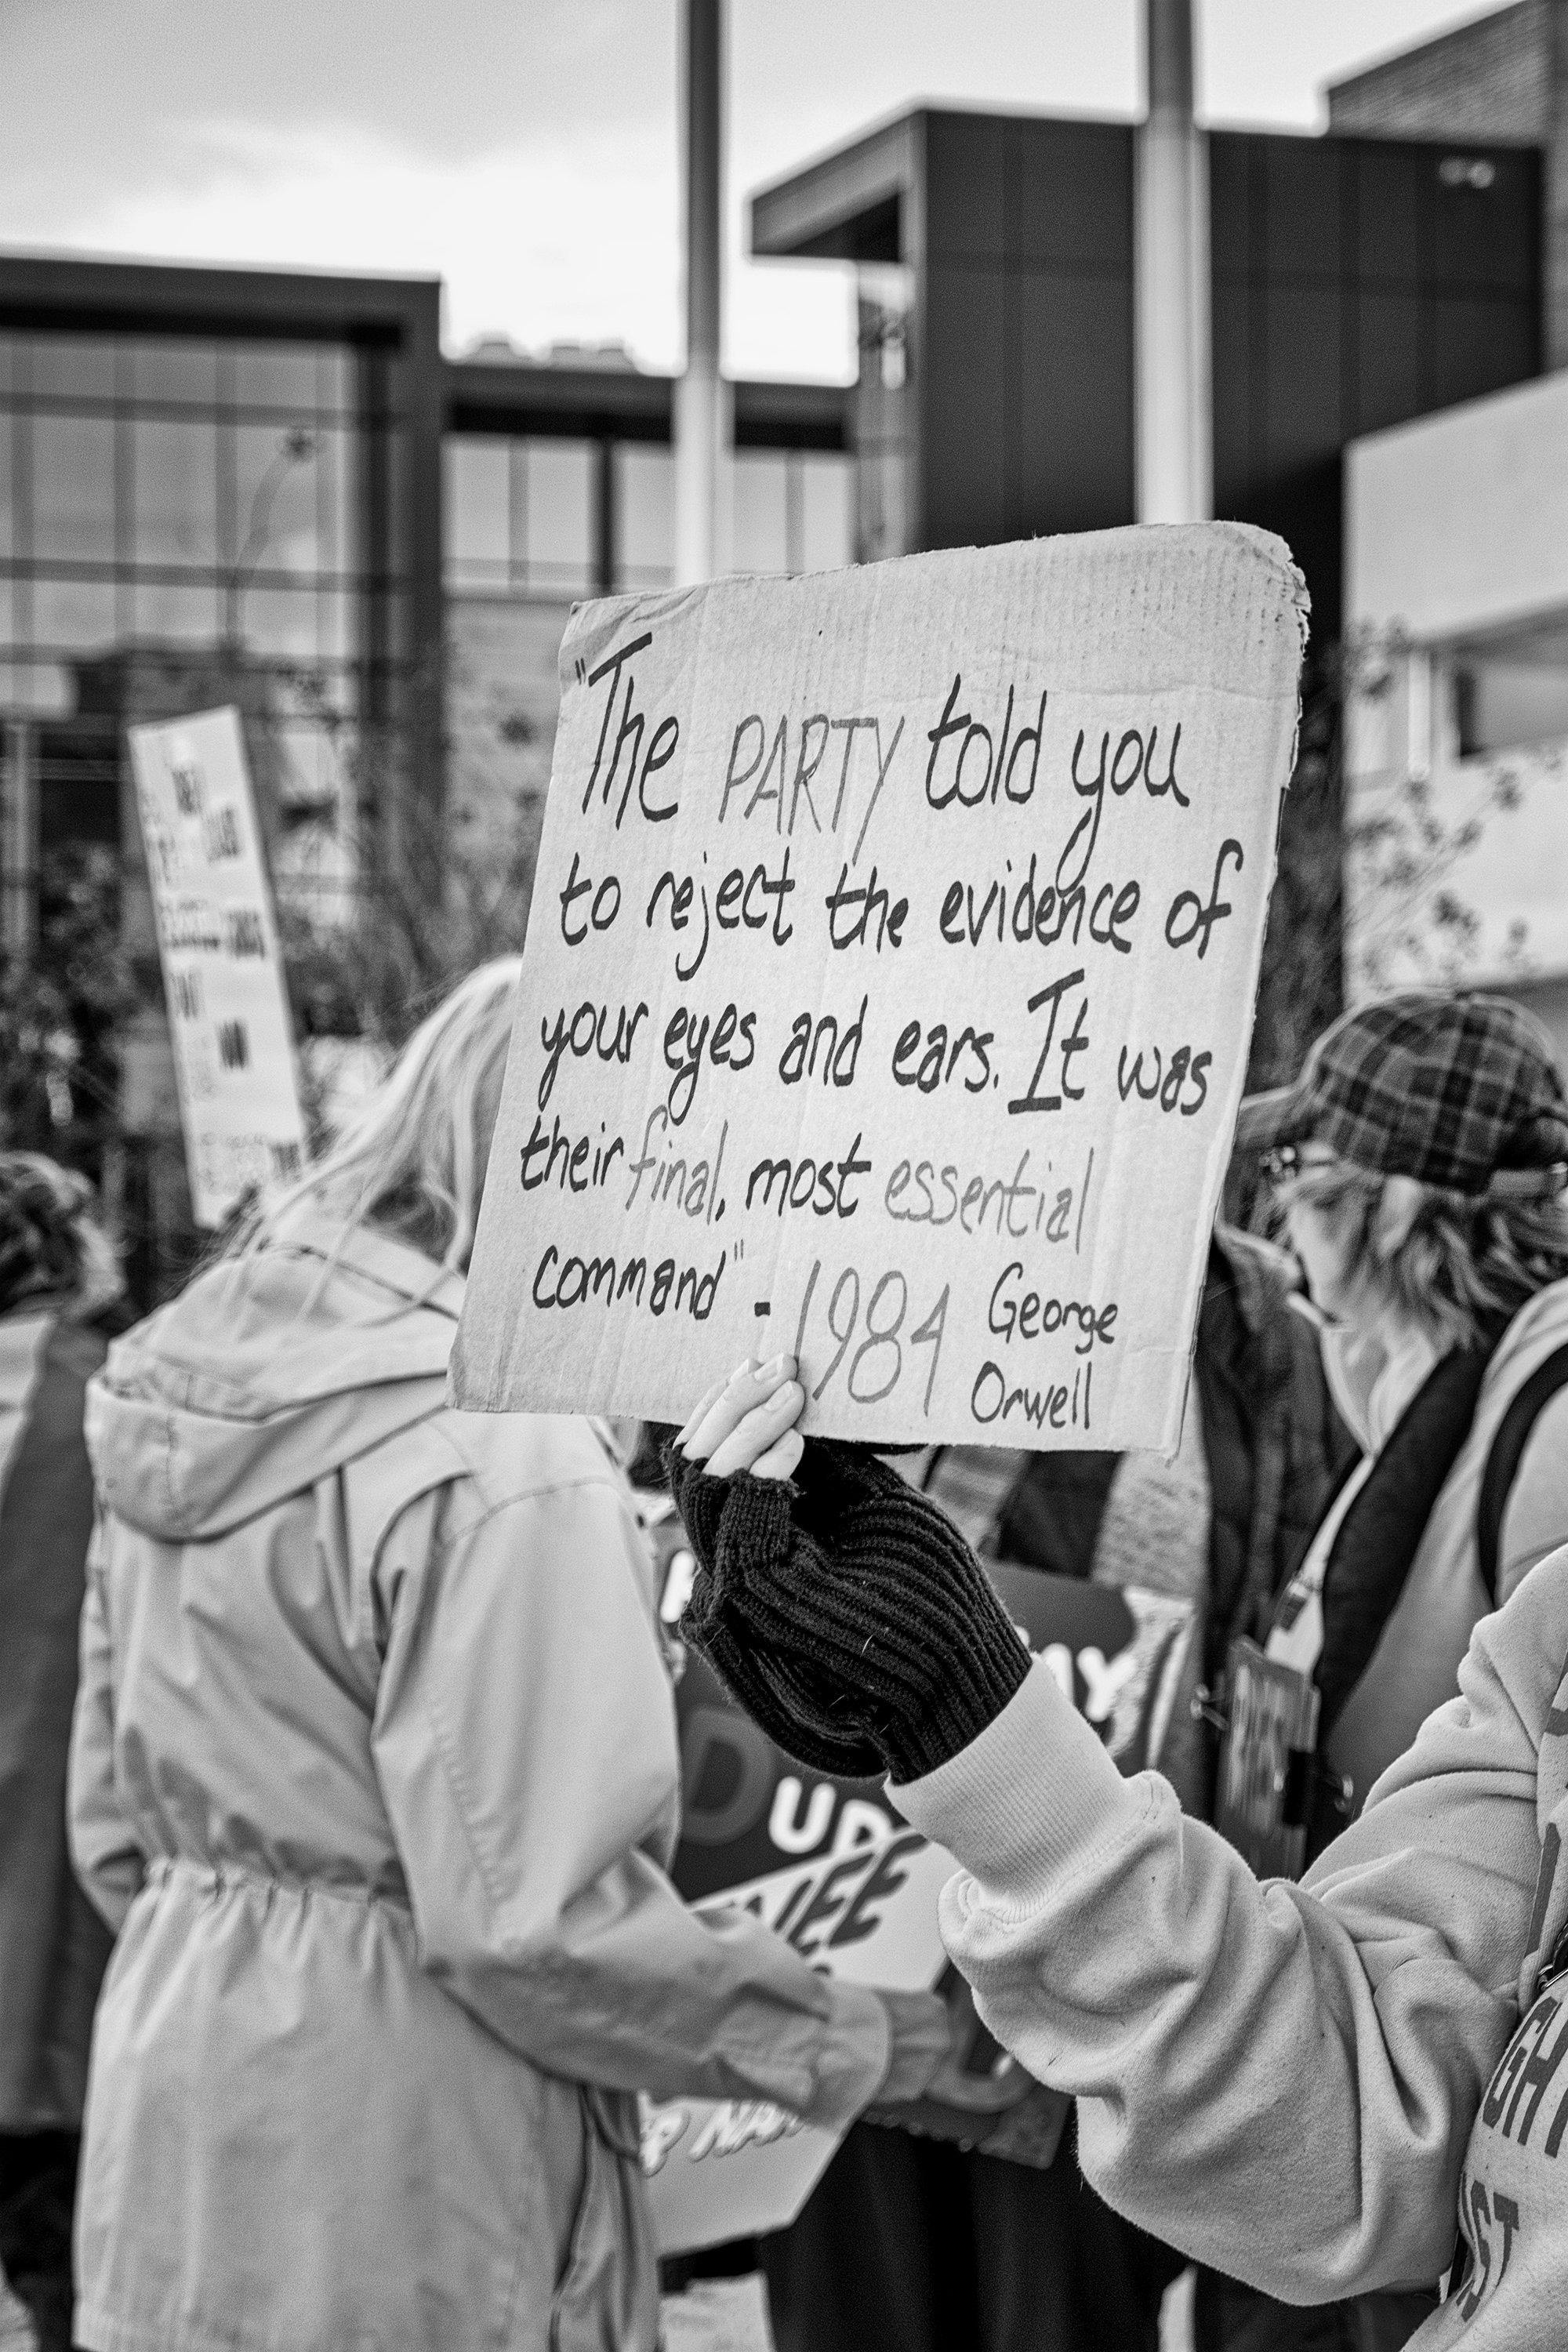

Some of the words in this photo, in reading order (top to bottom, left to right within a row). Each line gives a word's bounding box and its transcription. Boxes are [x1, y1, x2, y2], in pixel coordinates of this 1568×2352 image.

[574, 631, 681, 831] "The
[717, 713, 906, 868] PARTY
[925, 672, 1049, 811] told
[1054, 720, 1192, 894] you
[558, 851, 622, 947] to
[645, 844, 797, 982] reject
[823, 861, 910, 955] the
[938, 853, 1142, 955] evidence
[1163, 838, 1245, 960] of
[536, 998, 649, 1113] your
[662, 1000, 757, 1127] eyes
[777, 993, 869, 1088] and
[891, 1019, 1000, 1094] ears.
[1007, 967, 1090, 1116] It
[1116, 1044, 1214, 1116] was
[519, 1114, 626, 1193] their
[624, 1104, 730, 1226] final,
[744, 1131, 873, 1219] most
[883, 1146, 1096, 1255] essential
[531, 1239, 746, 1321] command"
[788, 1258, 951, 1420] 1984
[987, 1261, 1120, 1356] George
[970, 1359, 1094, 1431] Orwell
